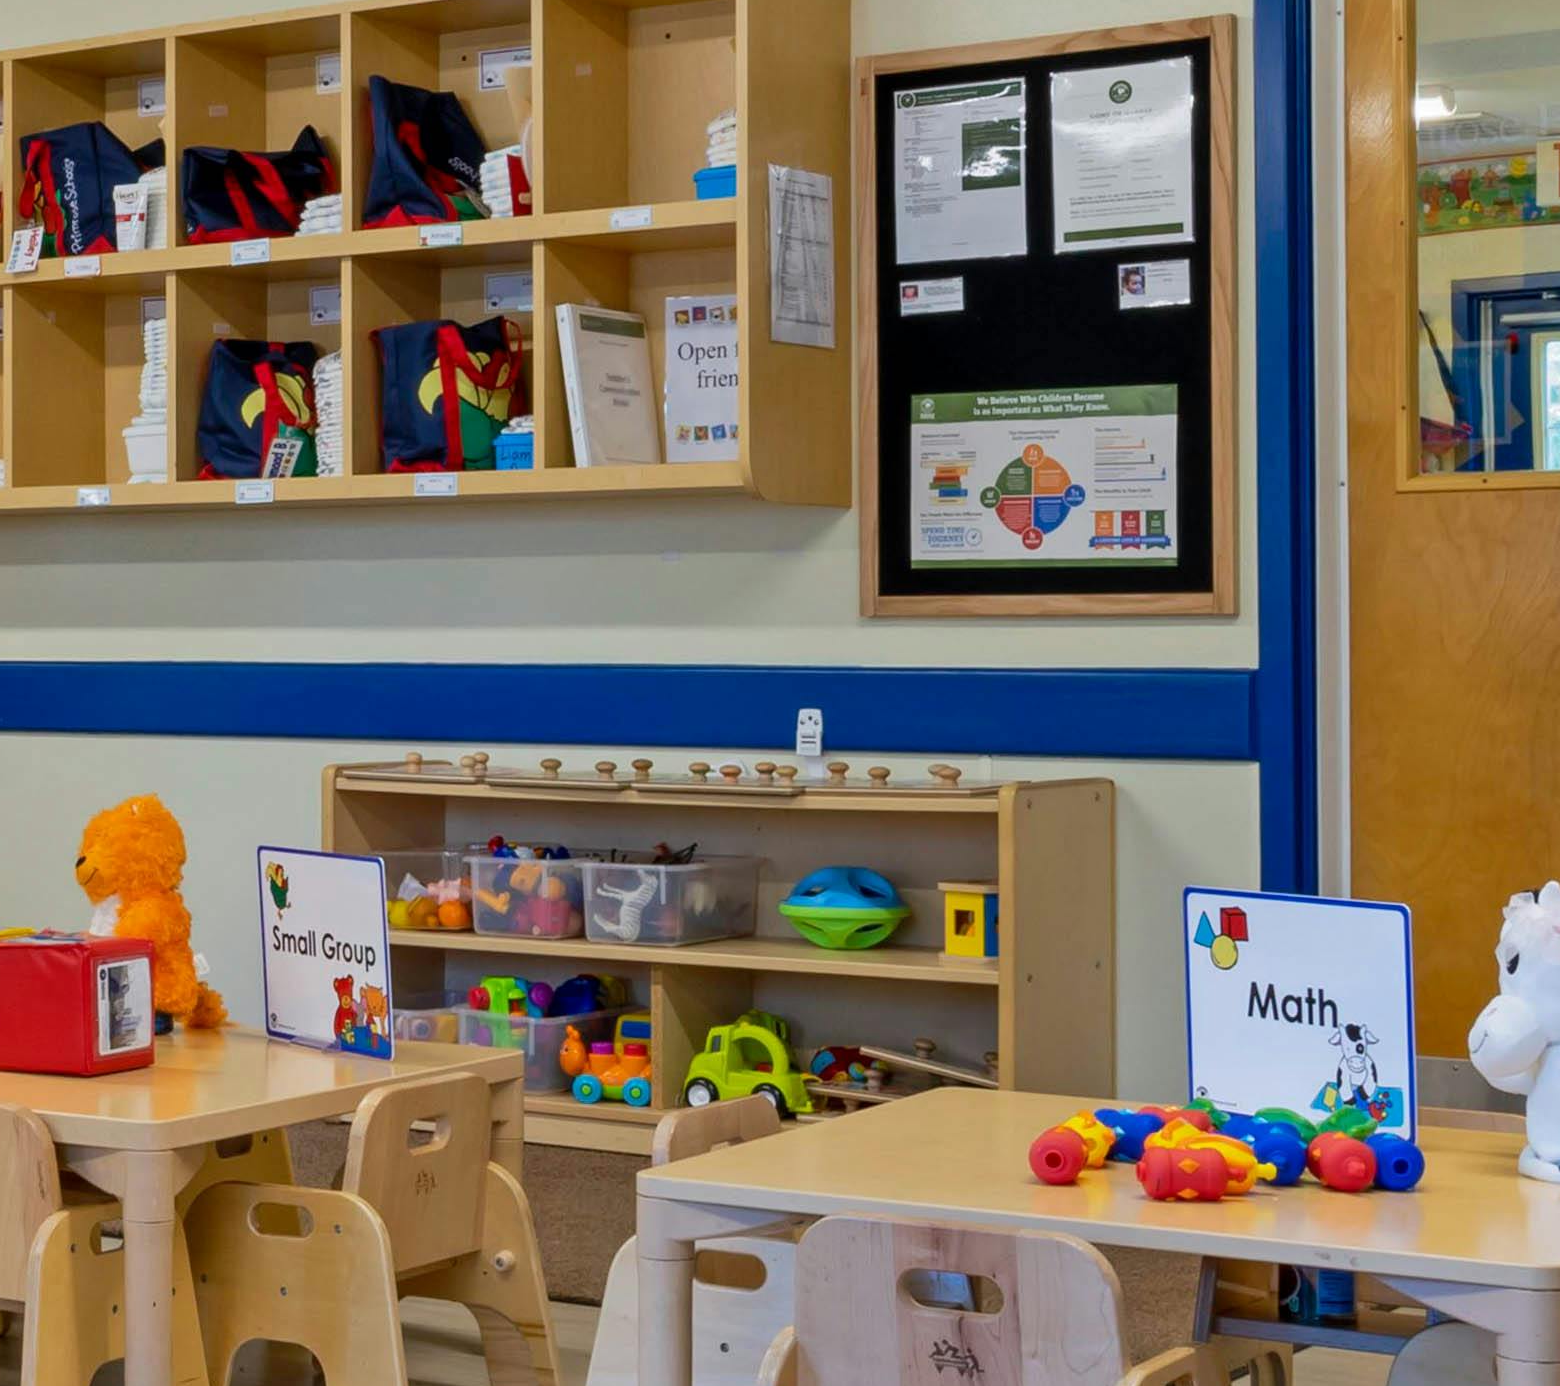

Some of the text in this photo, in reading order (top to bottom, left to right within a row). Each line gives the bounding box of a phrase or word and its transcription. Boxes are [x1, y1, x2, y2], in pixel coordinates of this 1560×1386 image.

[677, 341, 728, 365] Open
[696, 369, 739, 389] frien
[976, 392, 1105, 405] We Believe Who Children Become
[992, 406, 1031, 417] Important
[1043, 403, 1064, 413] What
[1065, 403, 1085, 414] They
[271, 923, 378, 973] Small Group
[1247, 980, 1340, 1029] Math
